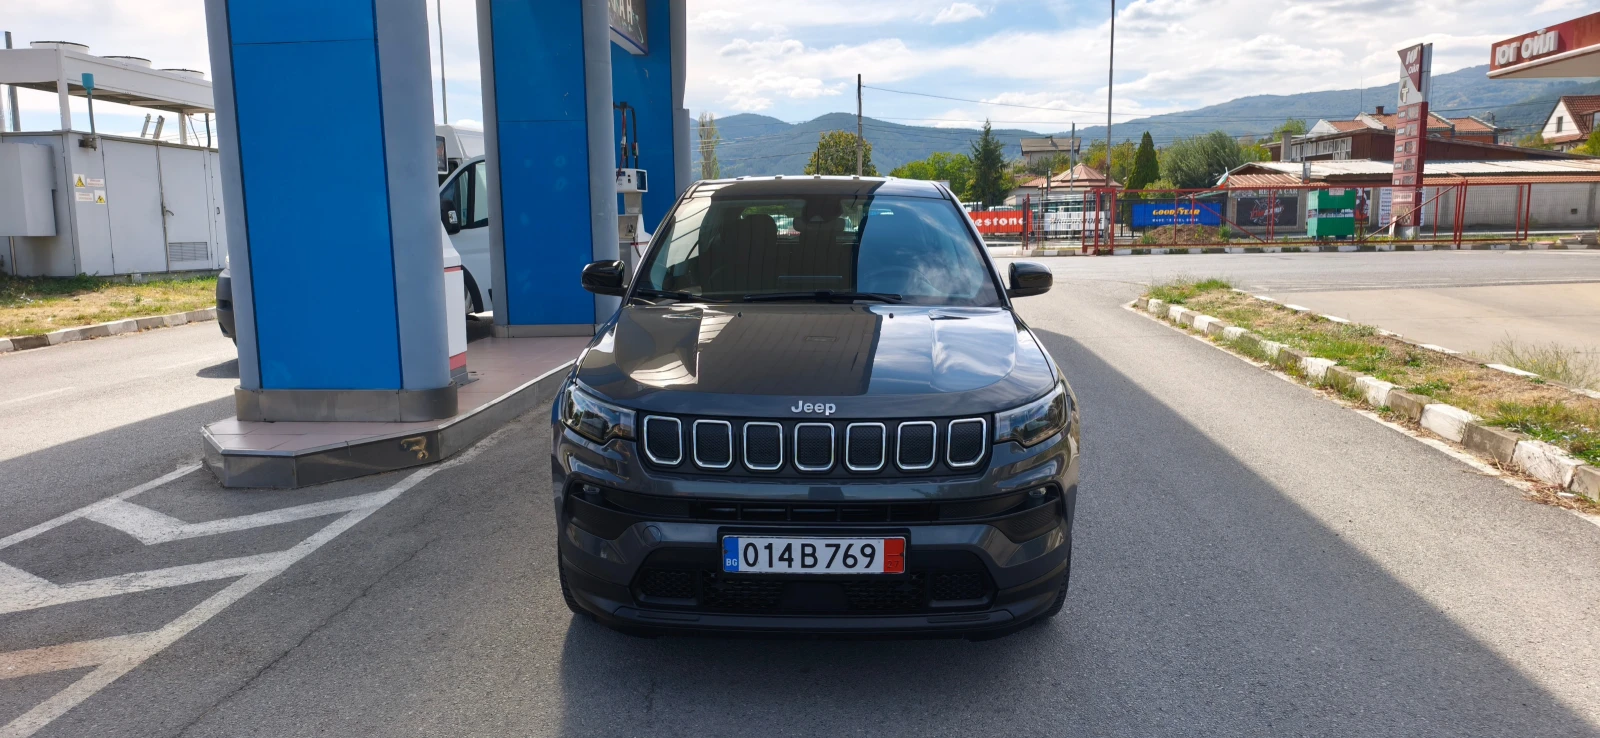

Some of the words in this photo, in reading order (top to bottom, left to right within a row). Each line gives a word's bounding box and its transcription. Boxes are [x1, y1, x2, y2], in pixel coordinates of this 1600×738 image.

[1495, 41, 1520, 66] ЮГ
[1521, 28, 1559, 59] ОЙЛ
[972, 216, 1024, 227] estone
[791, 400, 836, 416] Jeep
[726, 558, 738, 567] BG
